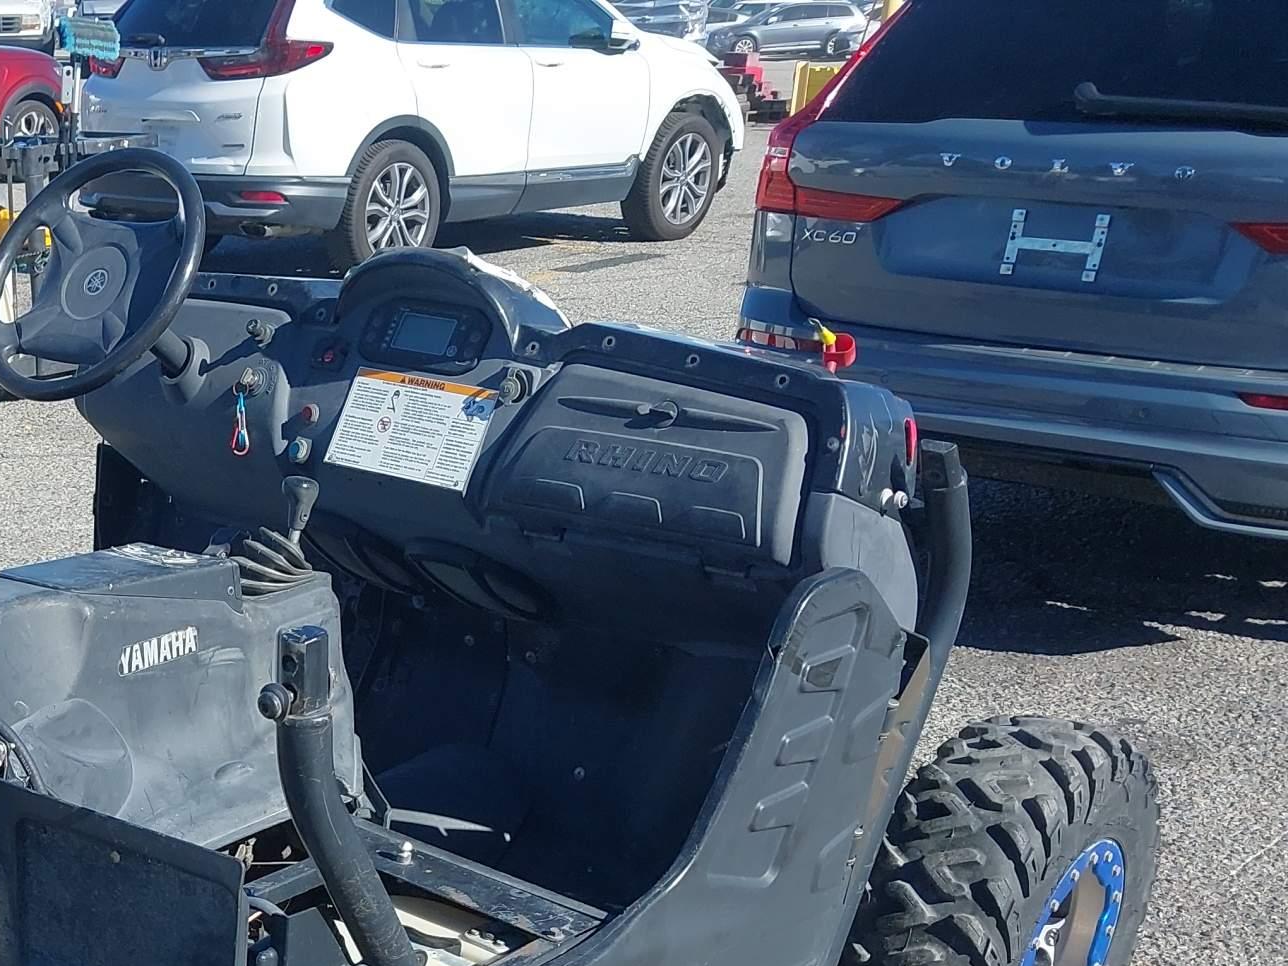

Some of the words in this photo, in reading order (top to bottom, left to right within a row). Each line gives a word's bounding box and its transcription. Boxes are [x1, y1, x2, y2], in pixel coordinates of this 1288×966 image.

[939, 152, 1196, 181] VOLVO
[801, 227, 858, 245] XC60
[407, 376, 446, 391] WARNING
[565, 439, 729, 482] RHINO
[120, 625, 199, 675] YAMAHA
